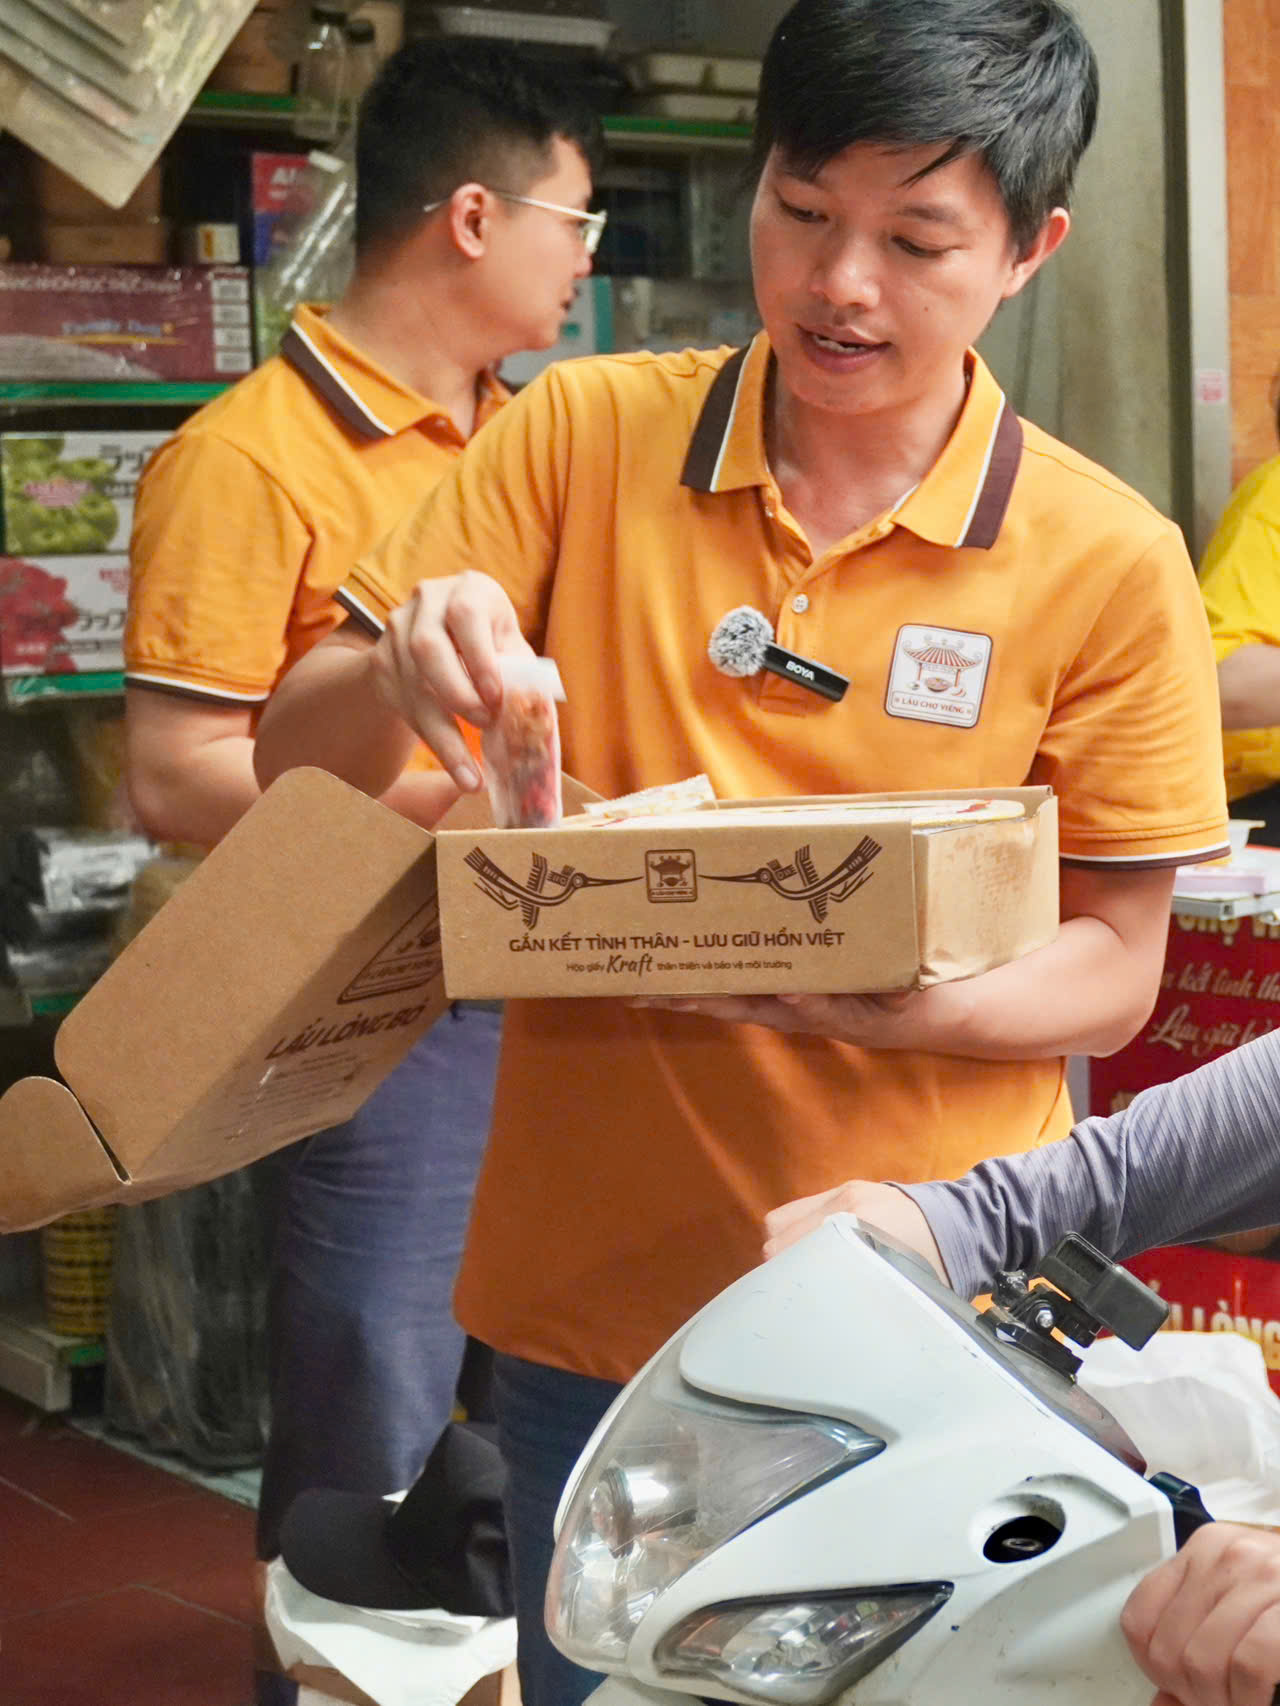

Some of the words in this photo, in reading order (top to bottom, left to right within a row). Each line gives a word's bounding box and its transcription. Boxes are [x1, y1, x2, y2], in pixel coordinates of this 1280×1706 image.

[785, 660, 815, 681] BOYA
[550, 931, 582, 951] KẾT
[585, 932, 627, 950] TÌNH
[630, 931, 679, 949] THÂN
[693, 932, 728, 948] LƯU
[806, 928, 845, 948] VIỆT
[606, 953, 653, 977] Kraft
